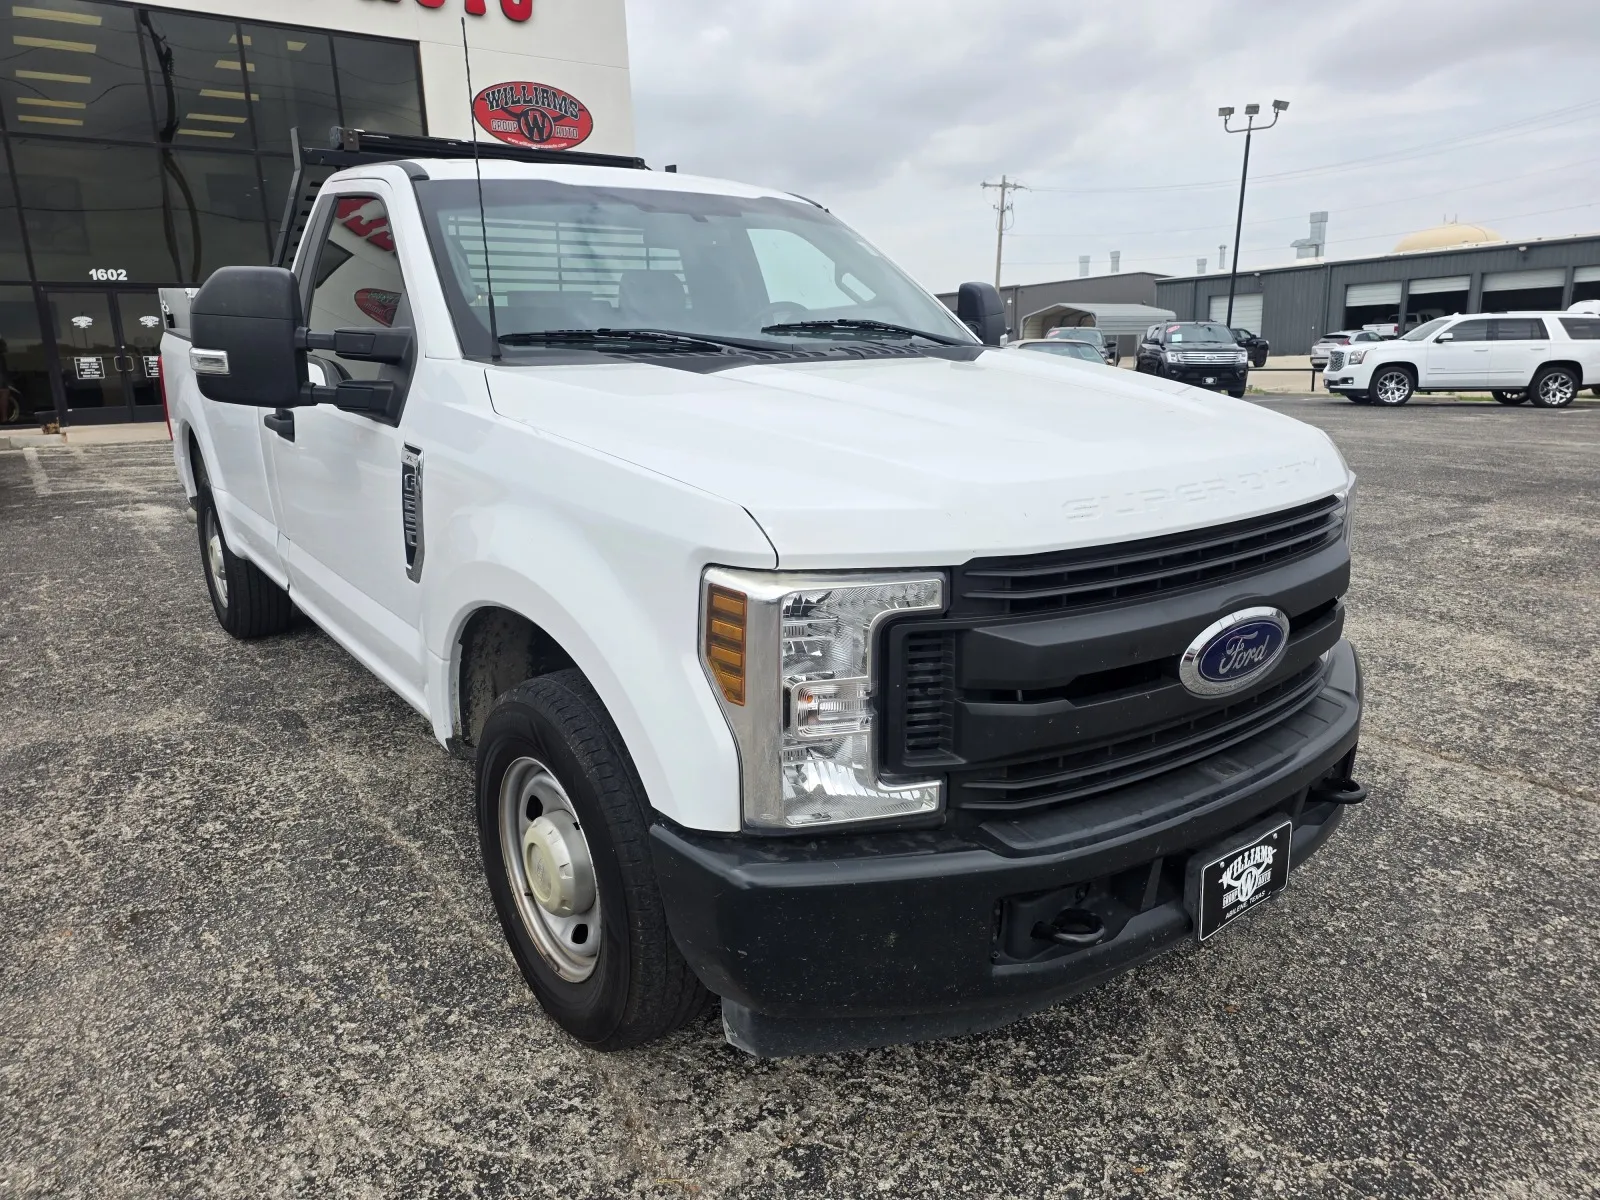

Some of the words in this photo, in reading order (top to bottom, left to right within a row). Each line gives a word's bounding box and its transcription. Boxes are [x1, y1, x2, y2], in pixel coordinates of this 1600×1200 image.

[485, 85, 579, 120] WILLIAMS
[491, 119, 519, 132] GROUP
[555, 126, 579, 139] AUTO
[89, 268, 128, 281] 1602
[1061, 477, 1236, 520] SUPER
[1238, 456, 1320, 491] DUTY
[1219, 630, 1270, 674] Ford
[1222, 845, 1273, 889] WILLIAMS
